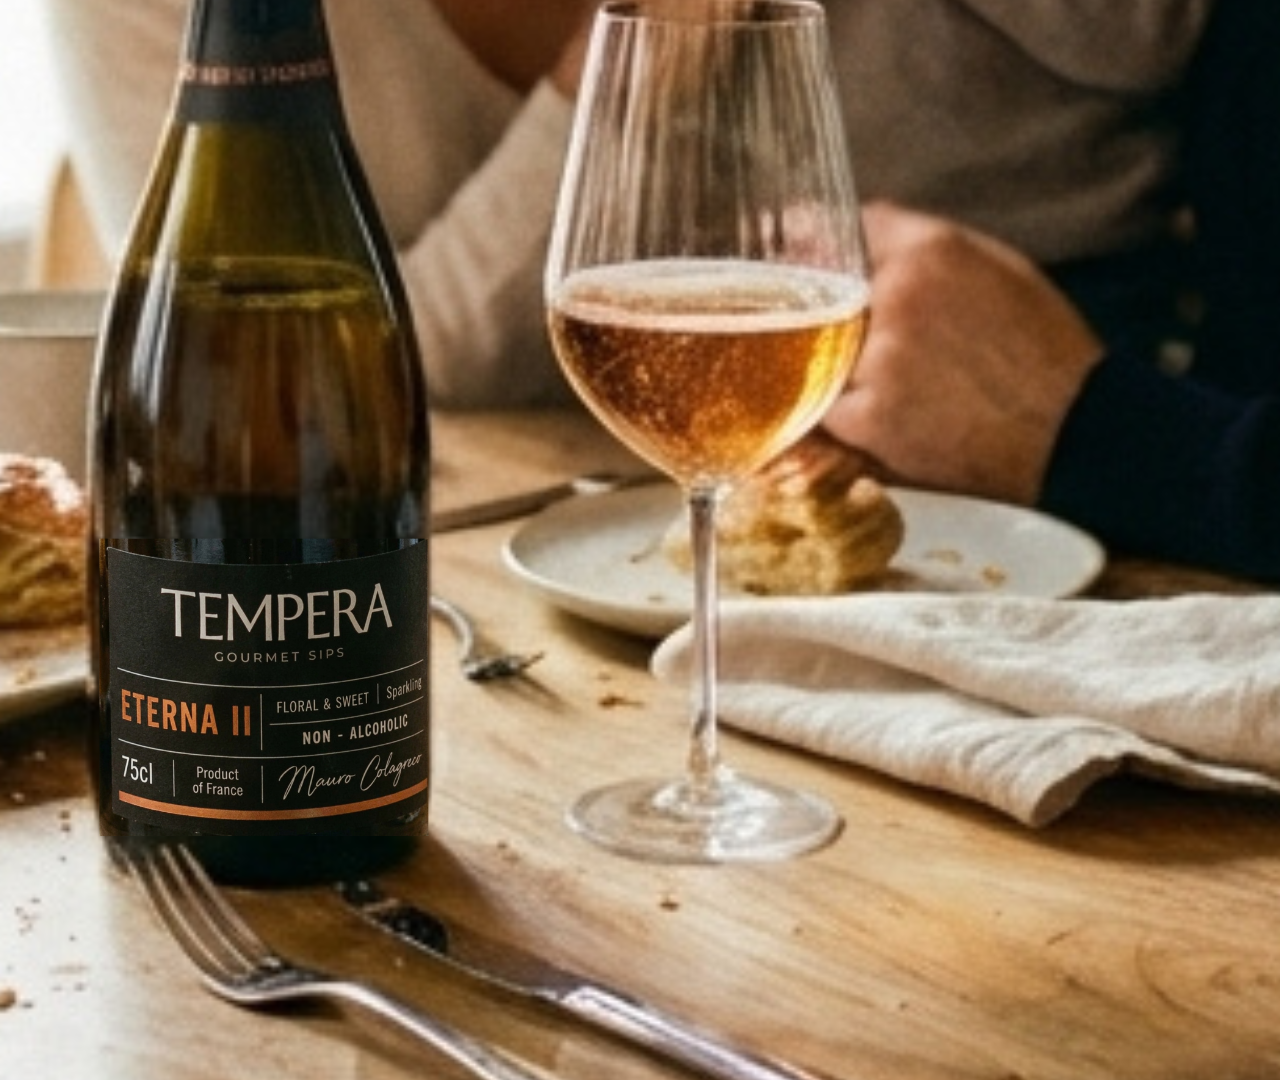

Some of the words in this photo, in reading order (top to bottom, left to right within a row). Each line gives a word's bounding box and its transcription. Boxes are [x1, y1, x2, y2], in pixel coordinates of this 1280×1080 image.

[160, 582, 393, 642] TEMPERA
[214, 651, 300, 663] GOURMET
[308, 647, 345, 661] SIPS
[276, 699, 319, 714] FLORAL
[323, 697, 331, 710] &
[335, 691, 370, 708] SWEET
[386, 677, 422, 701] Sparkling
[121, 688, 219, 735] ETERNA
[232, 705, 251, 736] II
[302, 729, 331, 745] NON
[349, 713, 408, 740] ALCOHOLIC
[121, 755, 153, 785] 75cl
[196, 766, 240, 781] Product
[278, 765, 356, 801] Mauro
[192, 782, 204, 794] of
[206, 783, 244, 796] France
